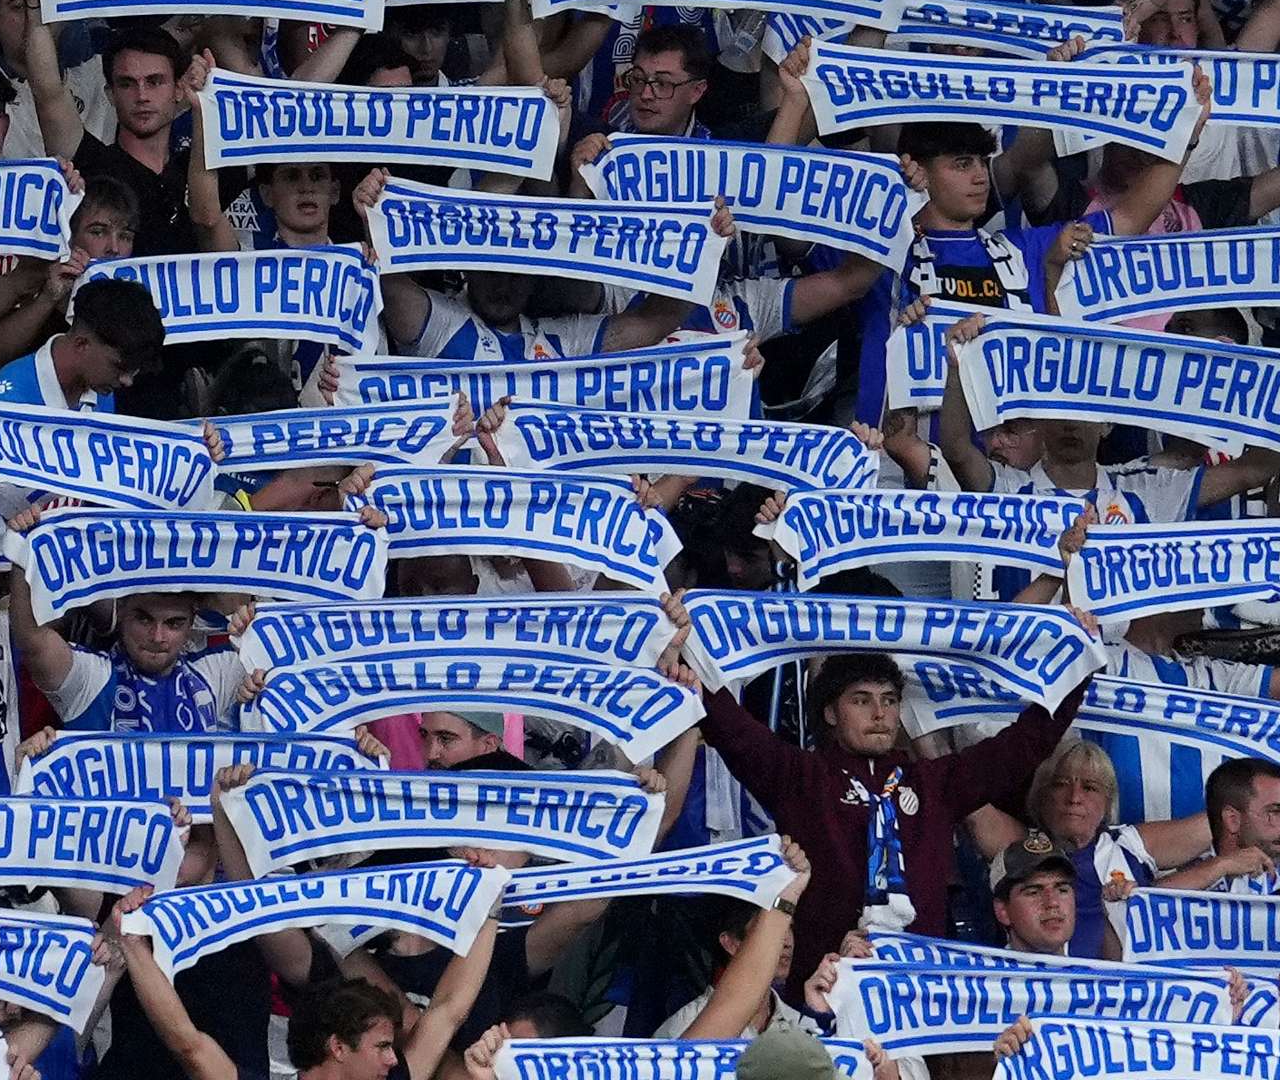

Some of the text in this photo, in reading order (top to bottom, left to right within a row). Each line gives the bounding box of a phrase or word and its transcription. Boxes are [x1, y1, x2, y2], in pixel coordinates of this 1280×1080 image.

[216, 90, 546, 152] ORGULLO PERICO
[821, 65, 1186, 131] ORGULLO PERICO
[775, 155, 908, 240] PERICO
[386, 201, 708, 276] ORGULLO PERICO
[1073, 239, 1254, 308] ORGULLO
[984, 337, 1161, 399] ORGULLO
[258, 417, 445, 456] PERICO
[522, 414, 725, 459] ORGULLO
[33, 520, 376, 590] ORGULLO PERICO
[785, 489, 941, 562] ORGULLO
[1084, 538, 1227, 601] ORGULLO
[252, 604, 654, 667] ORGULLO PERICO
[690, 598, 1088, 687] ORGULLO PERICO
[259, 667, 688, 731] ORGULLO PERICO
[27, 805, 171, 873] PERICO
[246, 776, 648, 849] ORGULLO PERICO
